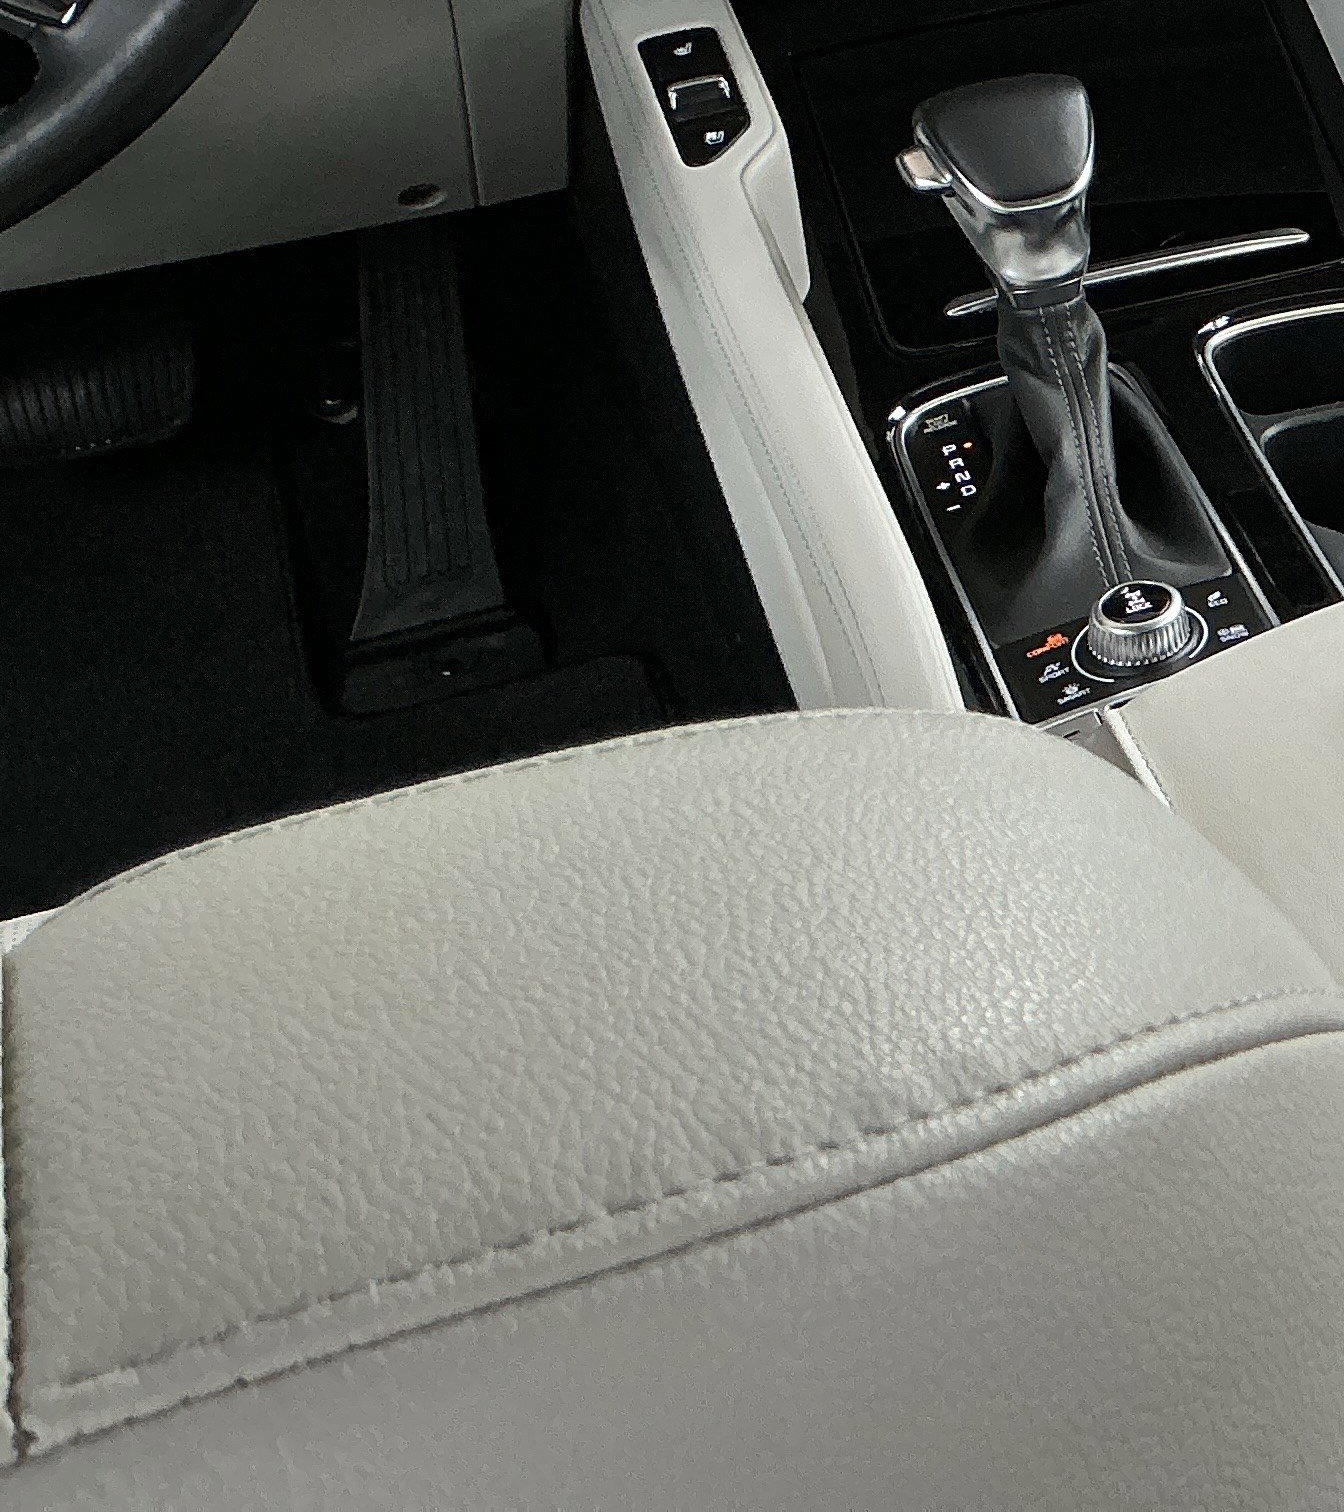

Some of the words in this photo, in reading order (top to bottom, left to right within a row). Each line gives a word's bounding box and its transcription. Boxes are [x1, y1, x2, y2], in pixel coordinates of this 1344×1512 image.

[942, 444, 957, 456] P
[948, 457, 965, 470] R
[954, 470, 971, 483] N
[960, 484, 977, 497] D
